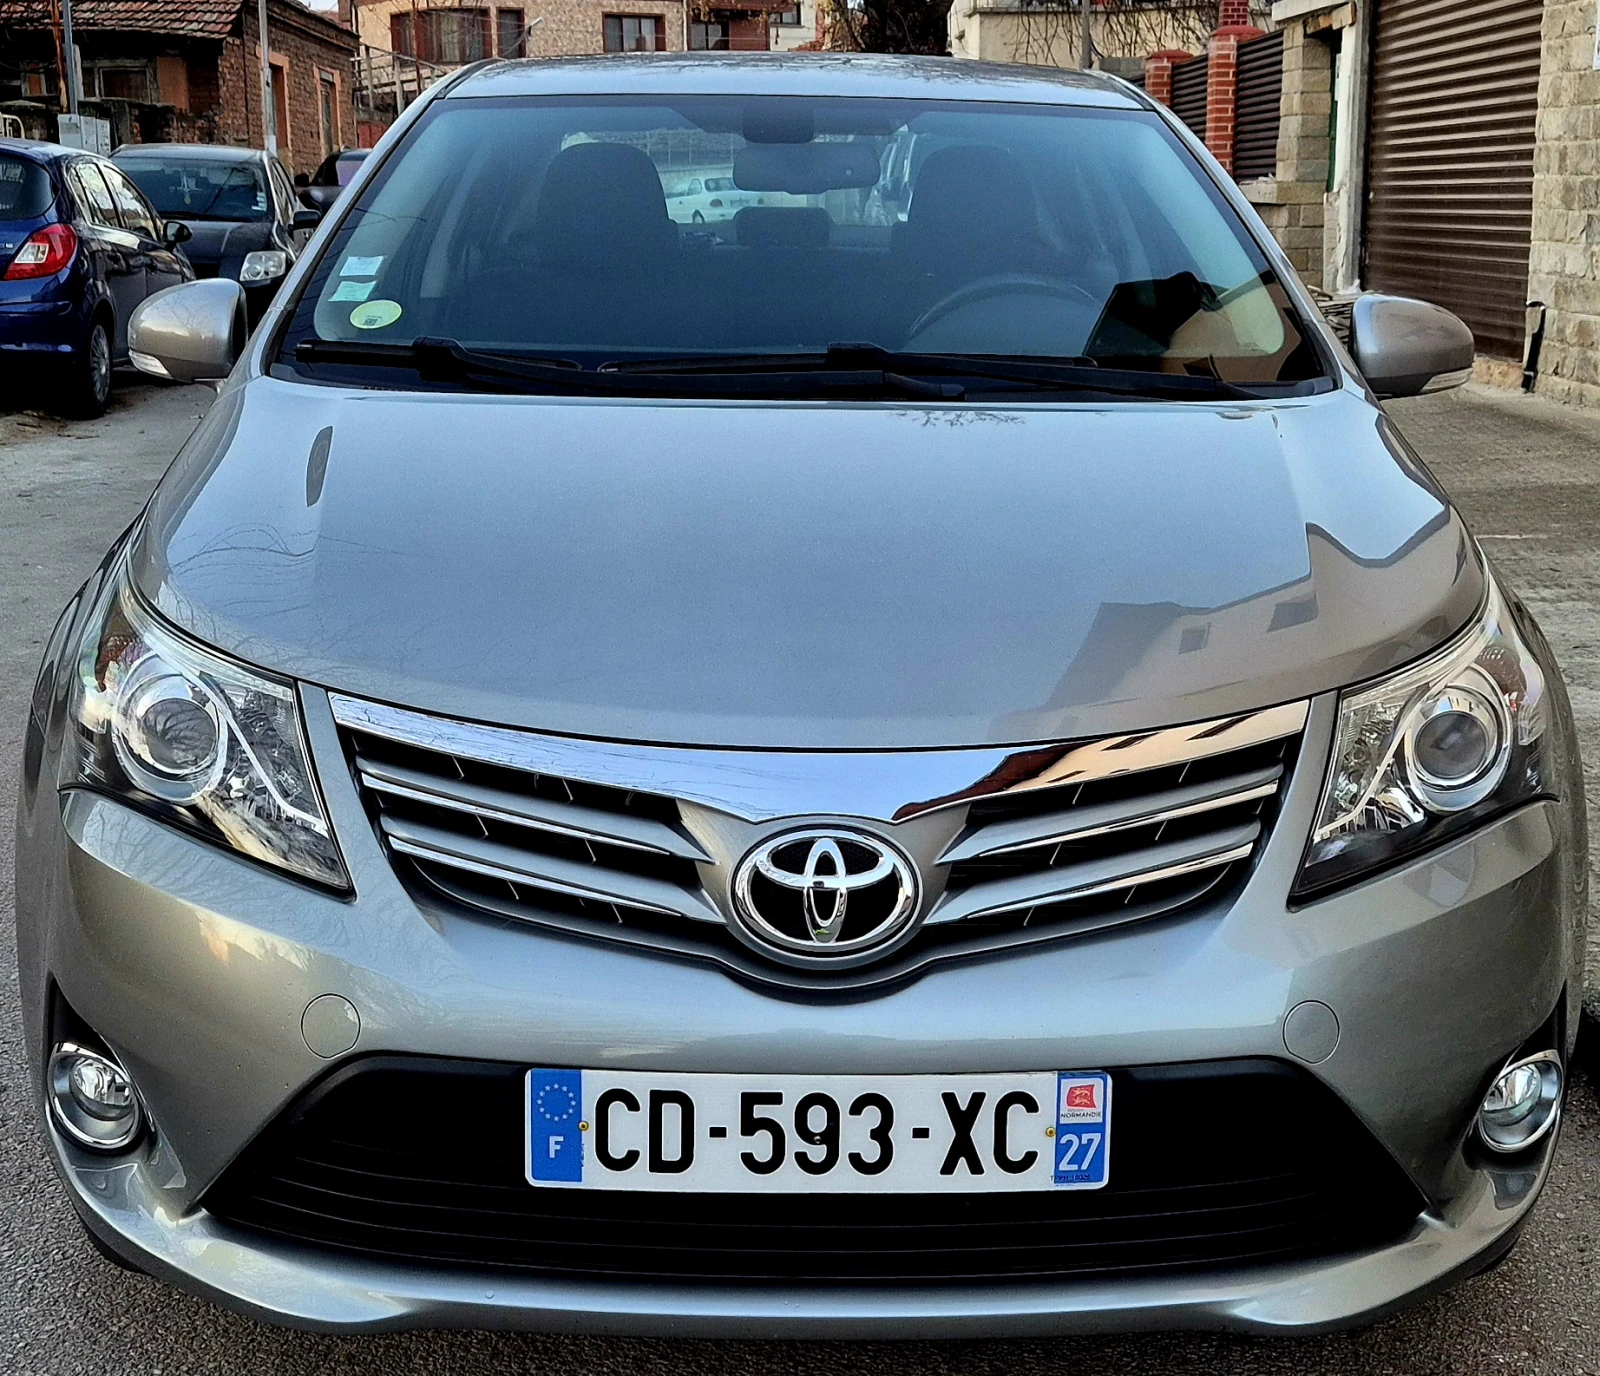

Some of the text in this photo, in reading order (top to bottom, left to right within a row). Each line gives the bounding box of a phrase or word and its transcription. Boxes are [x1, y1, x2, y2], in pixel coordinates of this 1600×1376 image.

[549, 1136, 564, 1159] F
[595, 1088, 1040, 1176] CD-593-XC
[1058, 1132, 1102, 1171] 27
